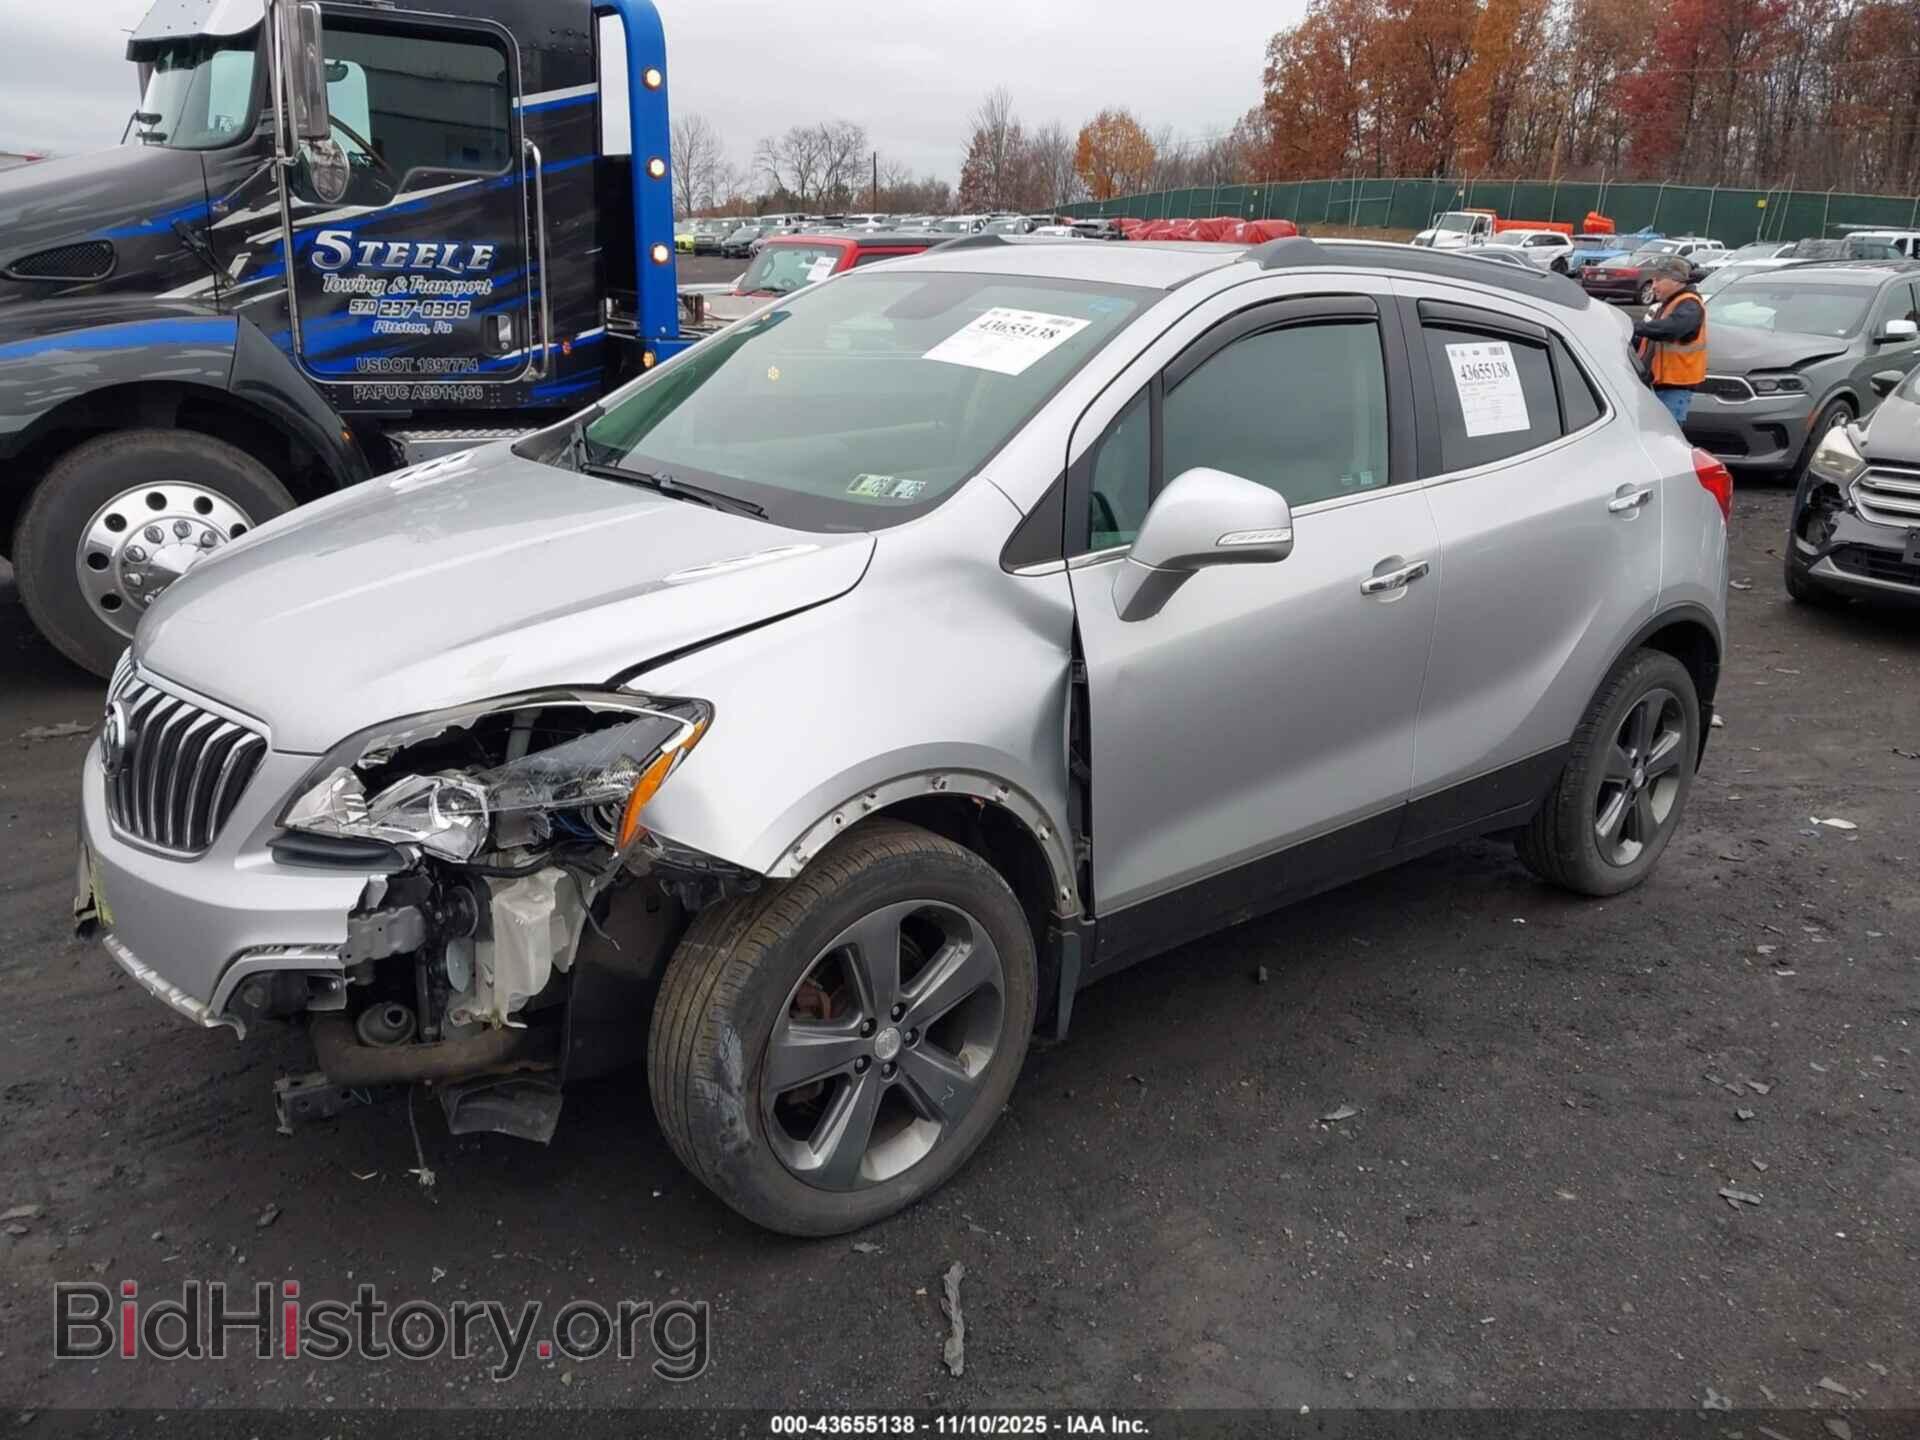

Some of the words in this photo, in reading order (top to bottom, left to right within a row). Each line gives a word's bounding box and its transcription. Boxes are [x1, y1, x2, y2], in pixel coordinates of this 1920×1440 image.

[311, 230, 495, 274] STEELE
[323, 273, 387, 296] Towing
[388, 276, 408, 294] &
[409, 276, 493, 297] Transport
[349, 299, 378, 315] 570
[377, 299, 471, 319] 237-0396
[372, 320, 431, 335] Pittston,
[433, 321, 453, 334] Pa
[980, 319, 1061, 339] 43655138
[356, 357, 415, 373] USDOT
[417, 357, 479, 373] 1897774
[1460, 362, 1511, 380] 43655138
[353, 384, 410, 400] PAPUC
